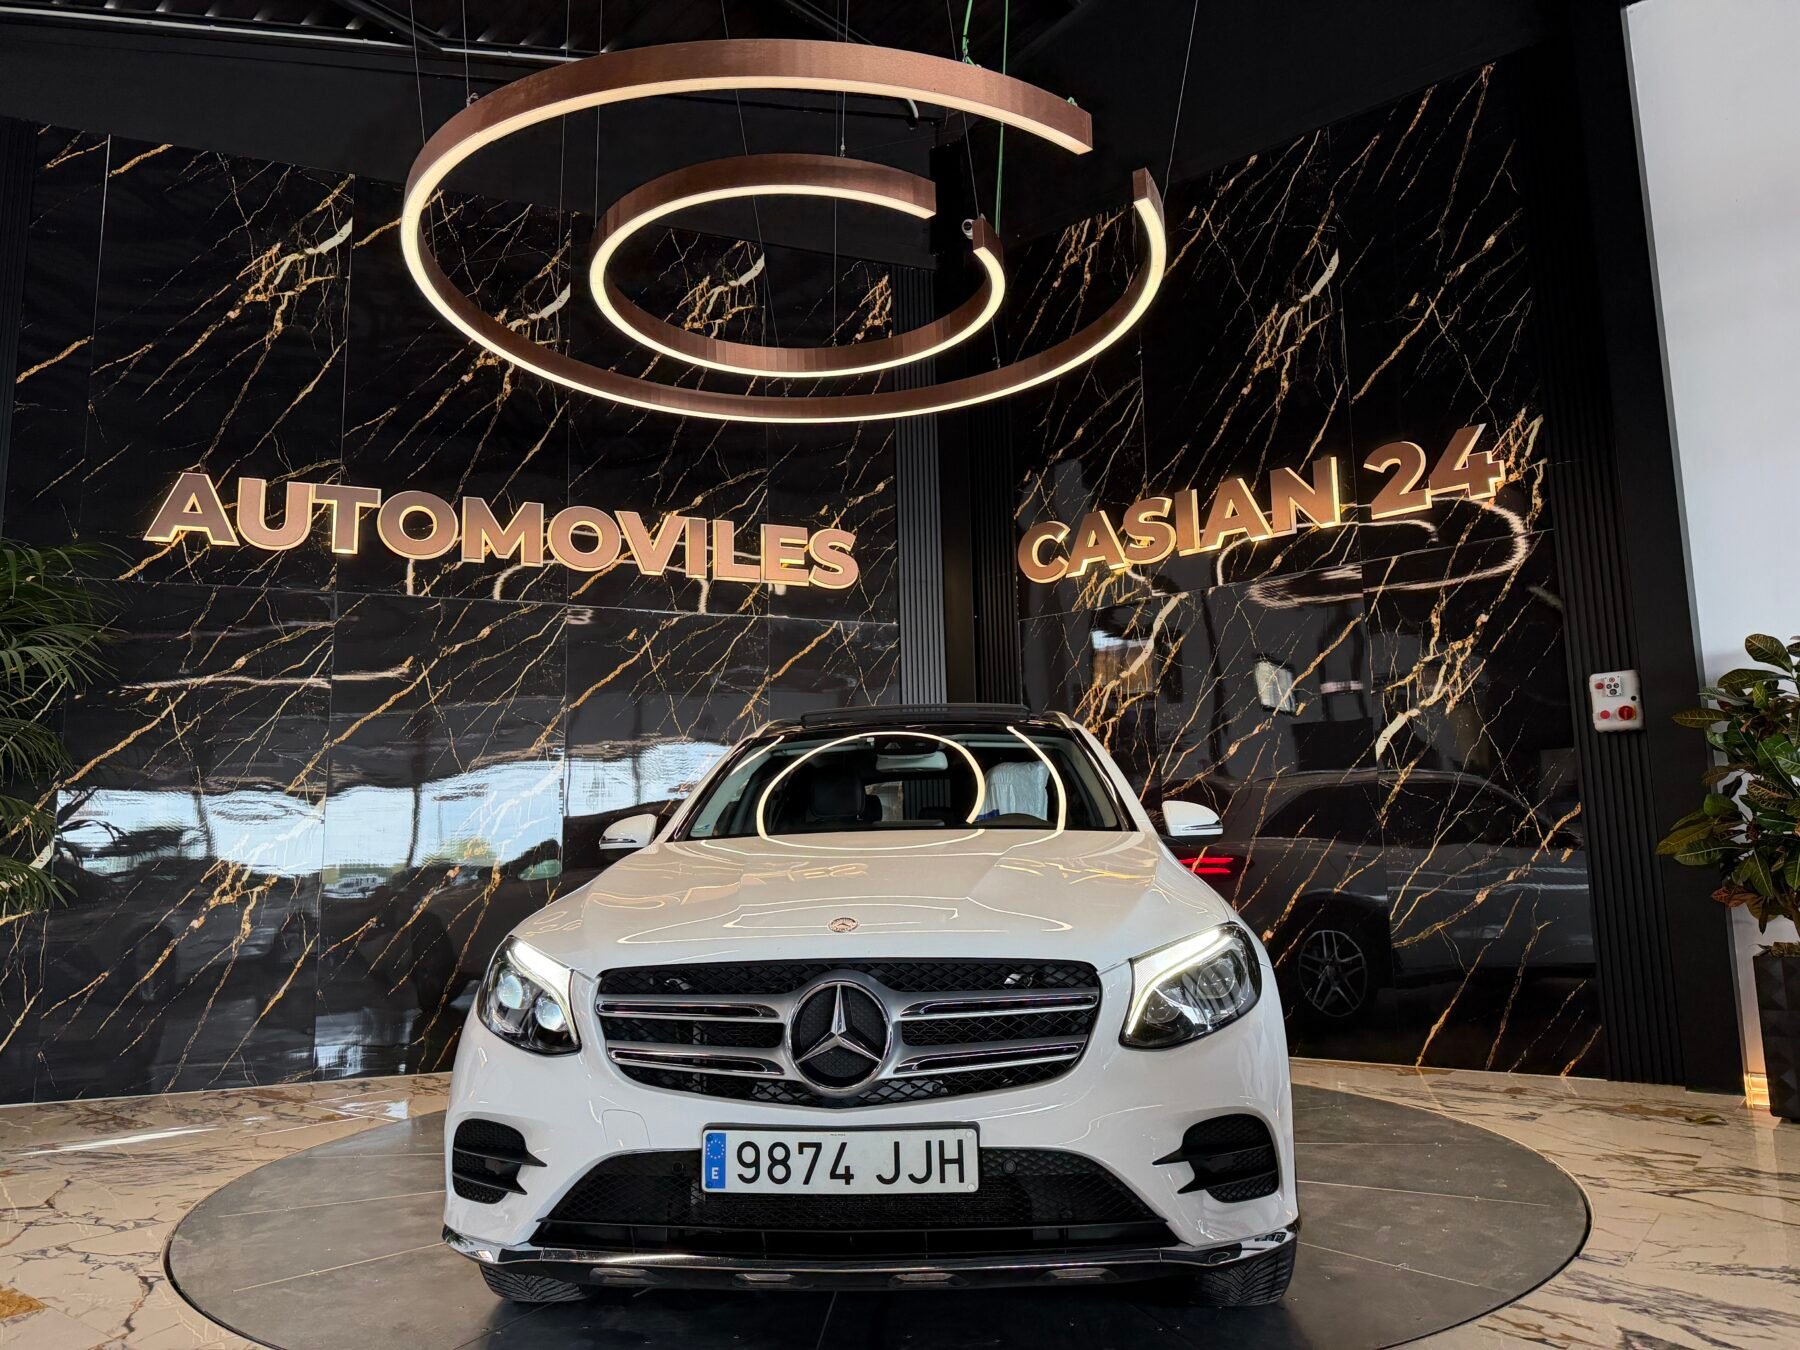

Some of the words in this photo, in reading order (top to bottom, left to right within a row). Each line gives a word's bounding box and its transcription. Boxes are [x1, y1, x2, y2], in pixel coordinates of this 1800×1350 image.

[143, 472, 860, 589] AUTOMOVILES
[1017, 456, 1342, 584] CASIAN
[1363, 423, 1506, 521] 24
[711, 1167, 719, 1180] E
[737, 1140, 854, 1186] 9874
[876, 1138, 965, 1186] JJH
